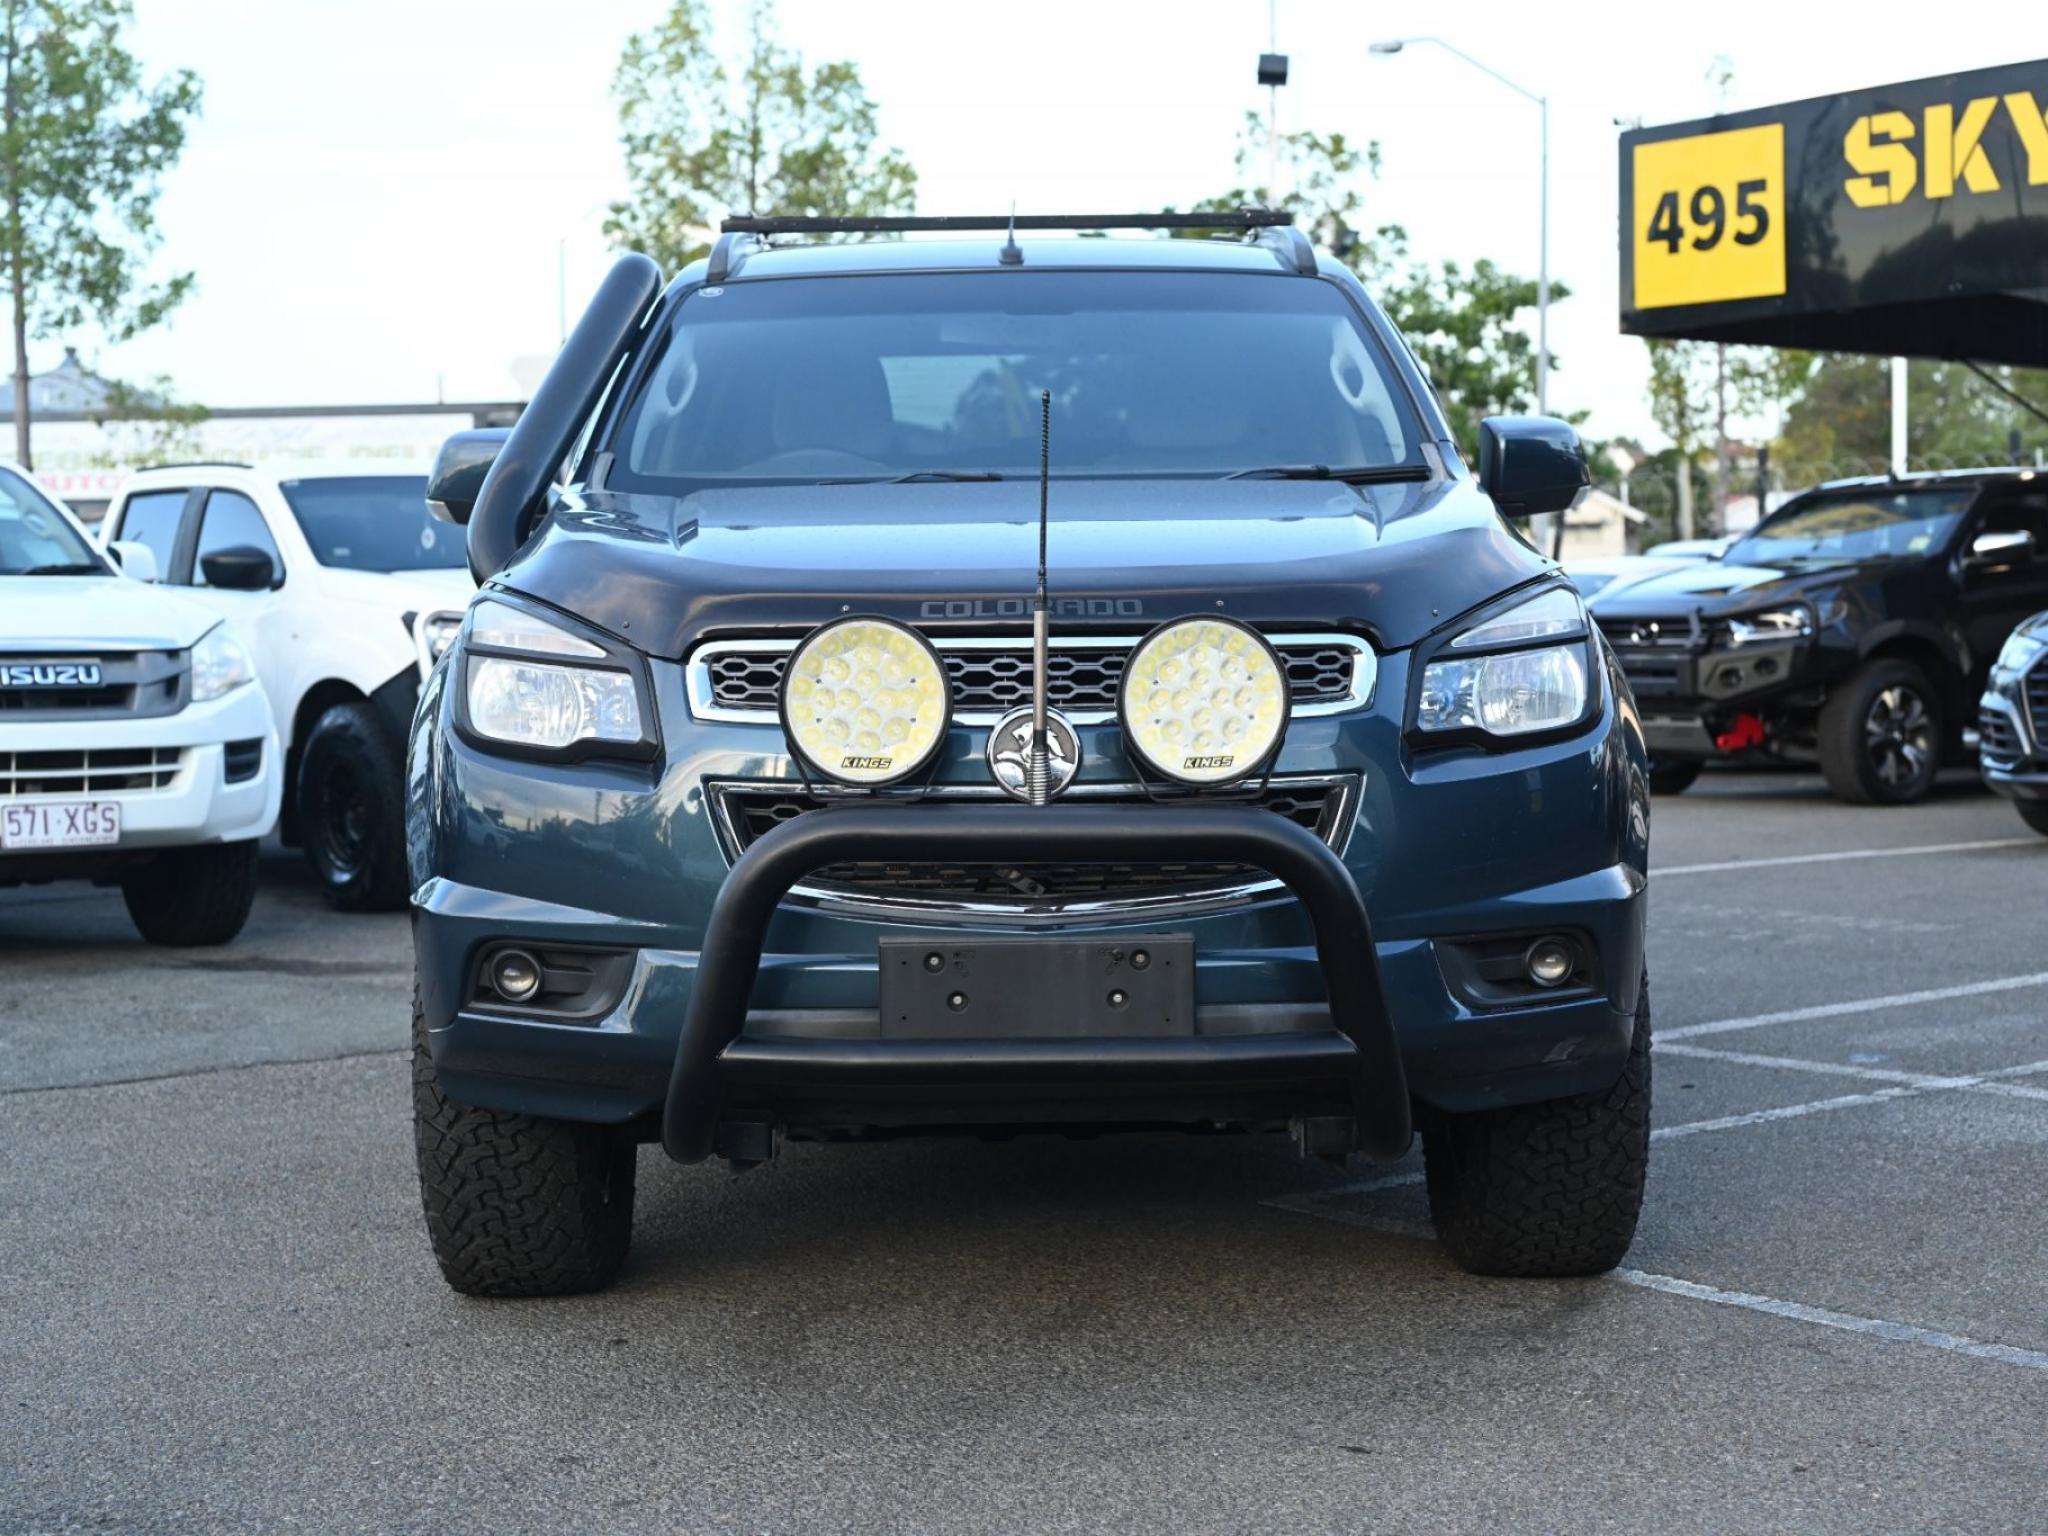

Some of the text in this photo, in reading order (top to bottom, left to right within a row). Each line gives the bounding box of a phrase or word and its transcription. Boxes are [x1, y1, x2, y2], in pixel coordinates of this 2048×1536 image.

[1647, 178, 1770, 255] 495
[0, 665, 101, 685] ISUZU
[841, 756, 893, 769] KINGS
[1183, 755, 1234, 769] KINGS
